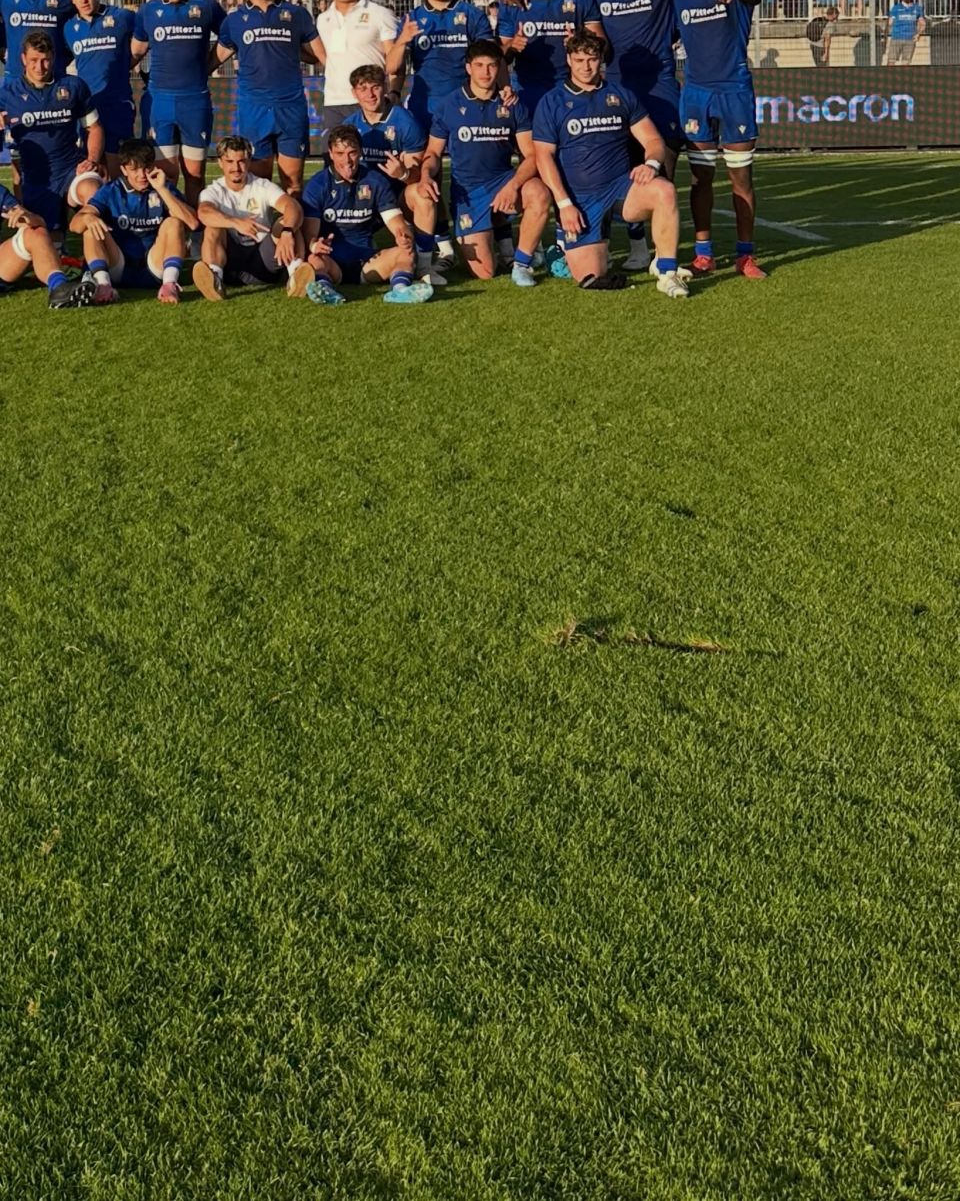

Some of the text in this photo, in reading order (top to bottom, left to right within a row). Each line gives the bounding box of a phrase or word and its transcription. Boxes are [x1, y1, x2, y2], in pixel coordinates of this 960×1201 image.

[690, 4, 726, 17] Vittoria
[21, 13, 57, 22] Vittoria
[165, 25, 202, 34] Vittoria
[253, 28, 291, 36] Vittoria
[81, 36, 116, 46] Vittoria
[430, 33, 468, 42] Vittoria
[755, 94, 915, 123] macron
[34, 109, 71, 119] Vittoria
[580, 116, 622, 126] Vittoria
[471, 126, 510, 135] Vittoria
